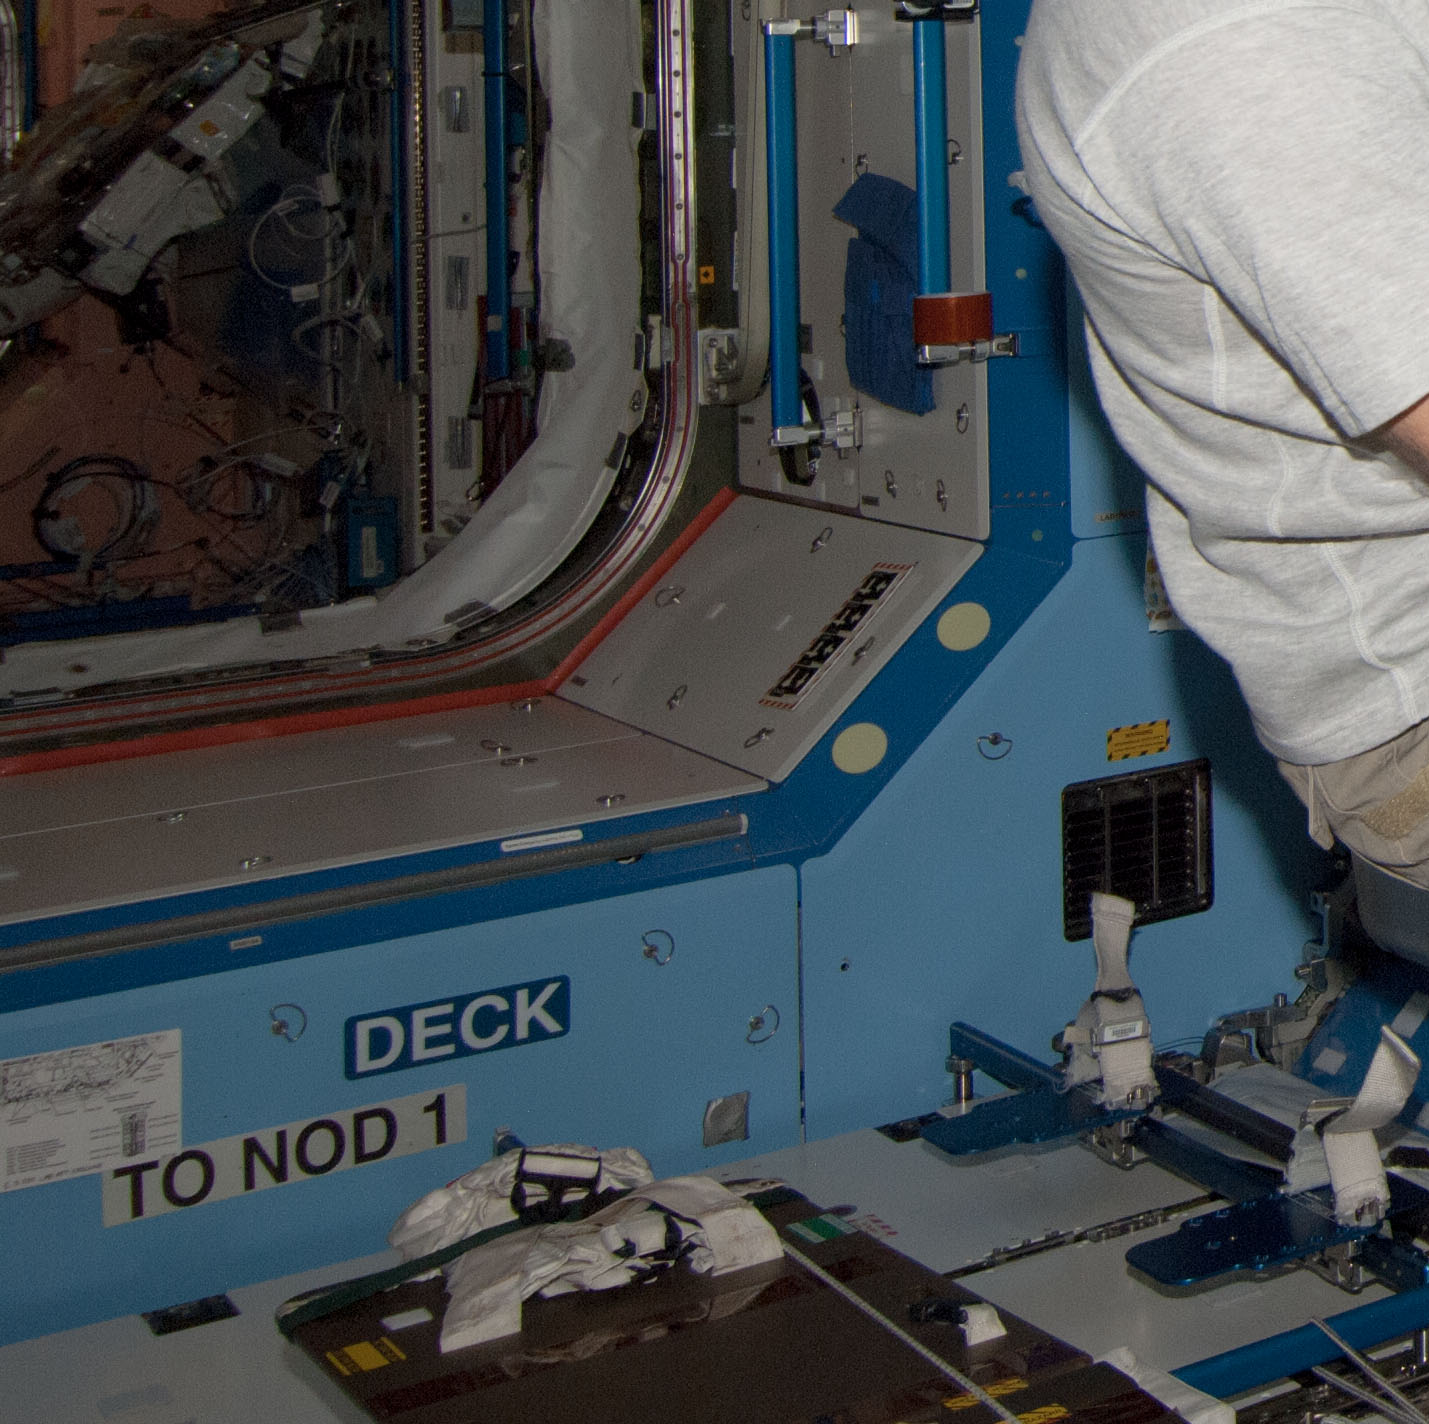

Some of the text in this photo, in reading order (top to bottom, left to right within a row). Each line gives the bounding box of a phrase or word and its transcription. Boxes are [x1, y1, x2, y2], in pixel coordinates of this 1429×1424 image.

[355, 981, 564, 1074] DECK
[113, 1149, 215, 1220] TO
[243, 1107, 399, 1192] NOD
[422, 1092, 447, 1146] 1
